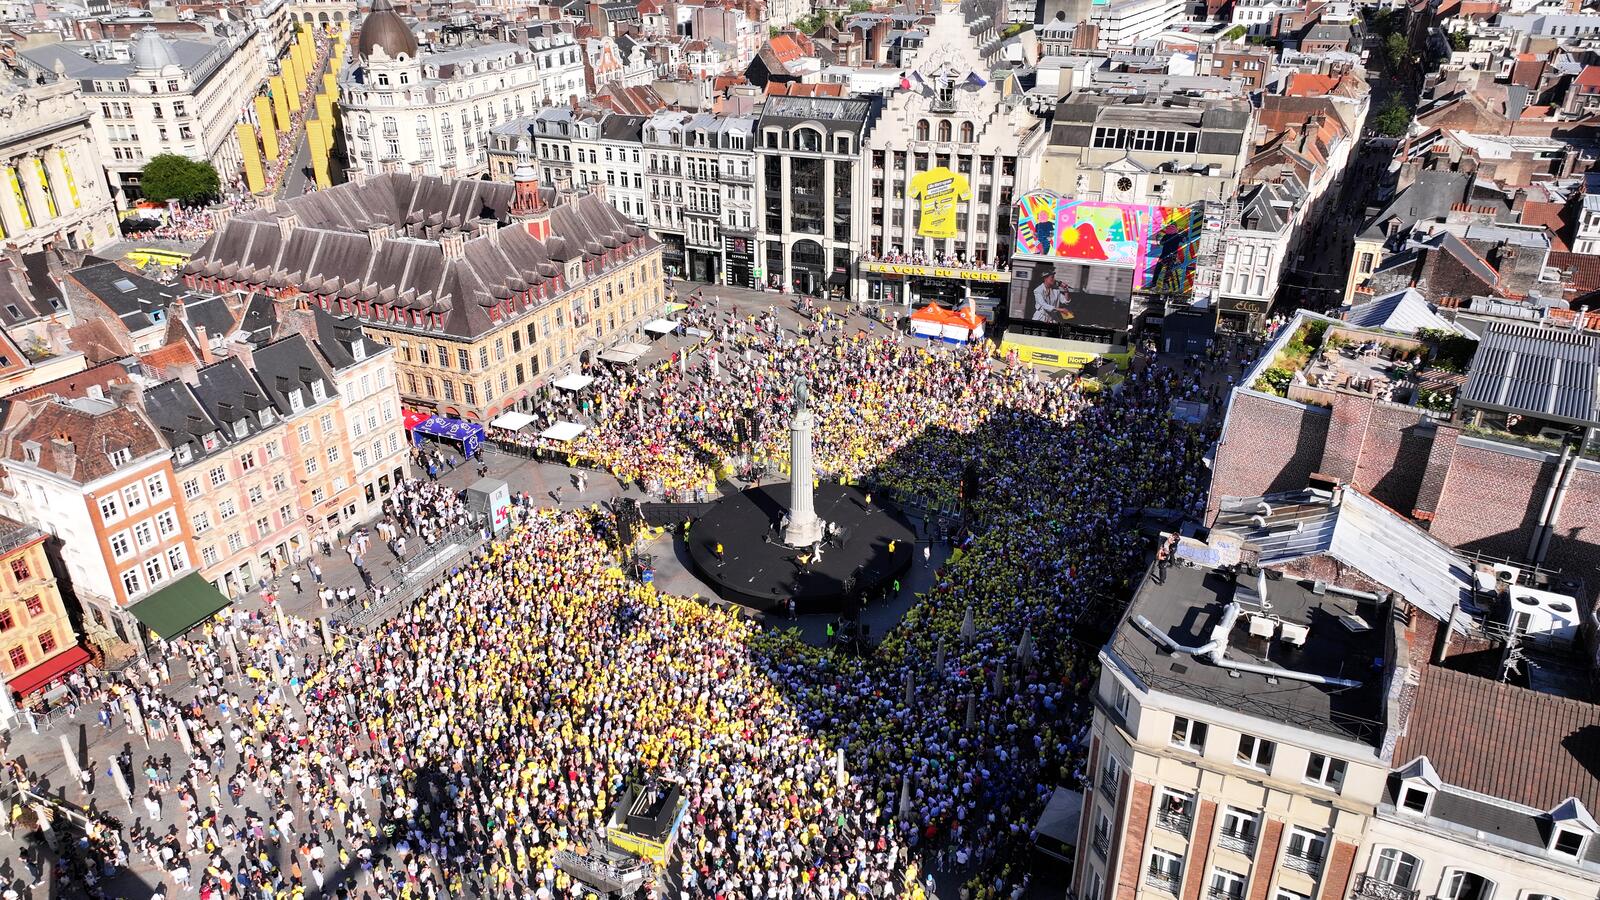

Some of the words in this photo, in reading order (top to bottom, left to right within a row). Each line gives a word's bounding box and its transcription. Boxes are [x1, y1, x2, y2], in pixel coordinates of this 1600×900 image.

[869, 264, 887, 273] LA
[892, 265, 925, 275] VOIX
[935, 269, 952, 277] DU
[960, 271, 999, 280] NORD
[1068, 356, 1088, 364] Nord
